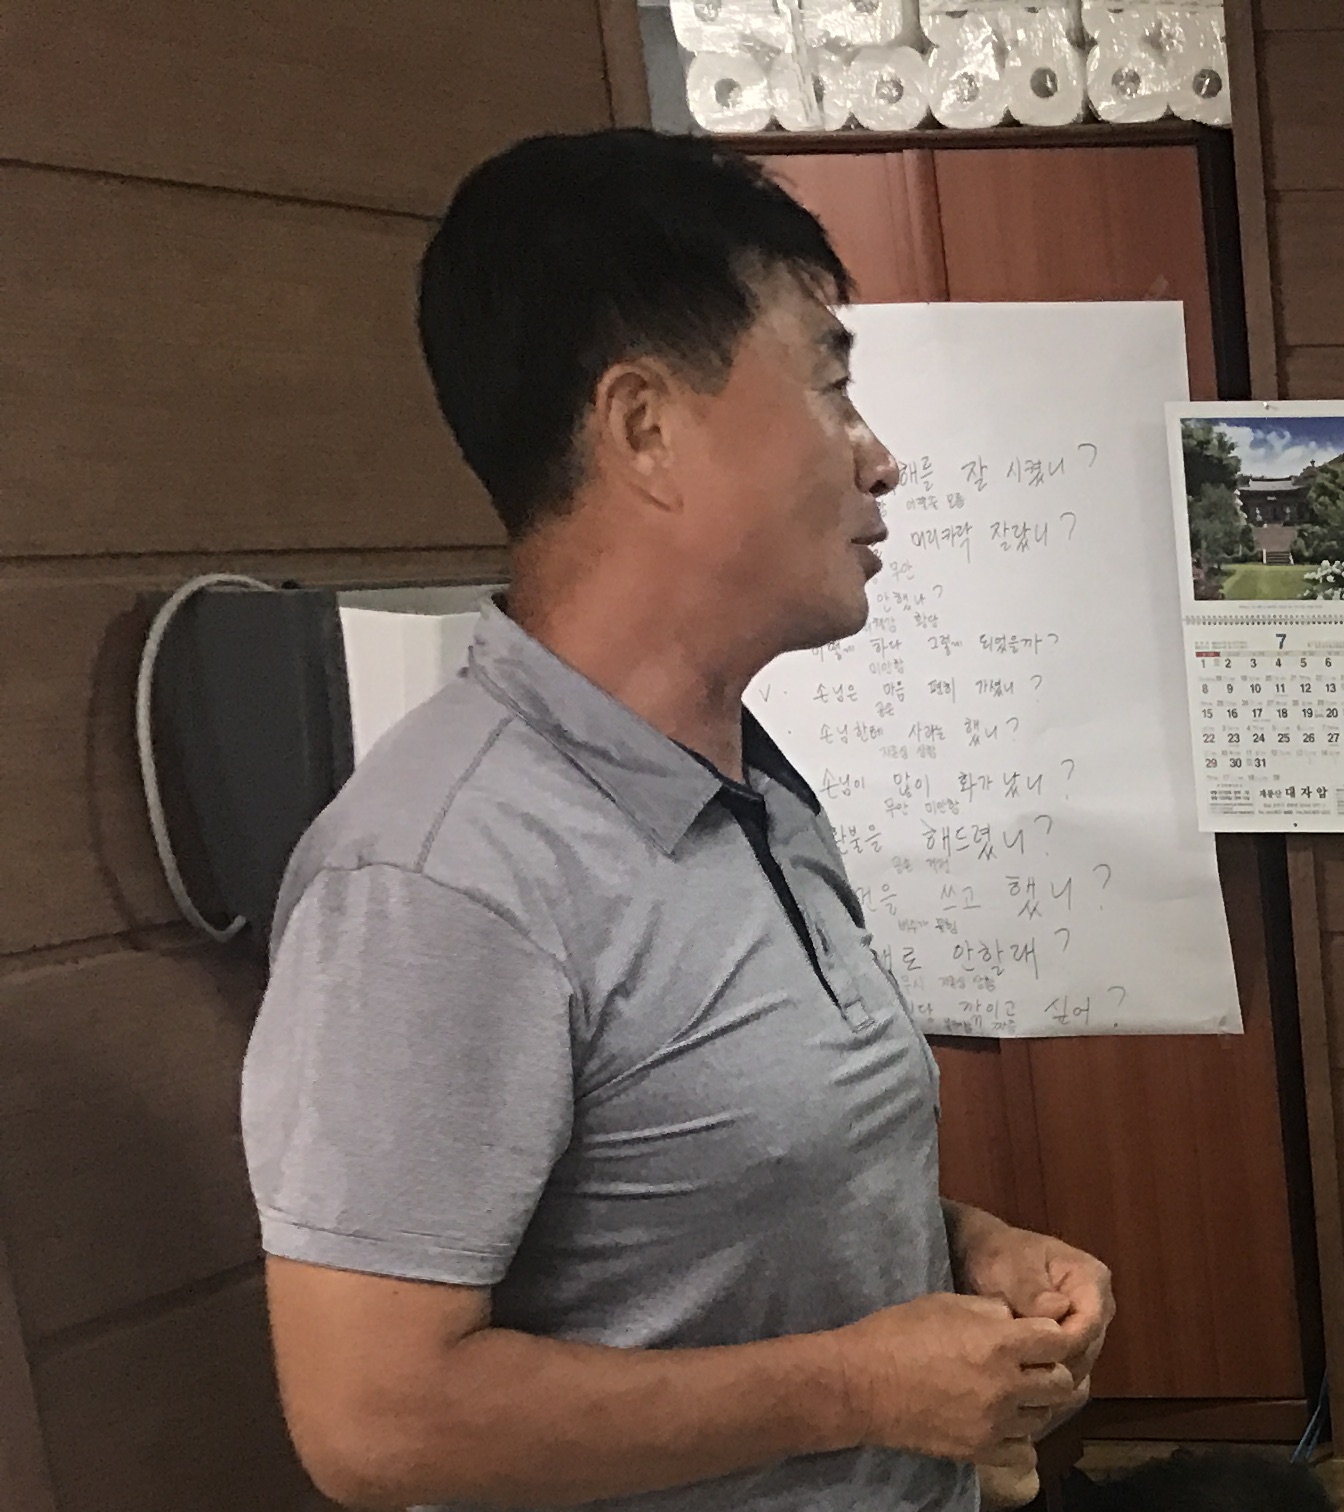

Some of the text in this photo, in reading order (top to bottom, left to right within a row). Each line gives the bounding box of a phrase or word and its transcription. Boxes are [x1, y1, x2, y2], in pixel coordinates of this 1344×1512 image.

[900, 456, 934, 491] 해를
[961, 456, 988, 492] 잘
[1276, 634, 1286, 649] 7
[1201, 659, 1205, 668] 1
[1225, 658, 1231, 668] 2
[1251, 659, 1257, 668] 3
[1276, 658, 1281, 667] 4
[1301, 658, 1307, 668] 5
[1325, 658, 1331, 667] 6
[813, 683, 857, 703] 손님은
[1202, 684, 1208, 694] 8
[1227, 684, 1233, 693] 9
[1250, 684, 1261, 693] 10
[1276, 684, 1285, 693] 11
[1300, 683, 1311, 693] 12
[1325, 683, 1336, 692] 13
[1202, 709, 1213, 718] 15
[1227, 708, 1238, 718] 16
[1252, 708, 1262, 718] 17
[1277, 708, 1288, 718] 18
[1302, 708, 1313, 718] 19
[1326, 708, 1338, 718] 20
[1203, 734, 1215, 743] 22
[1228, 733, 1240, 743] 23
[1253, 733, 1265, 743] 24
[1278, 733, 1290, 743] 25
[1303, 733, 1315, 743] 26
[1328, 733, 1339, 742] 27
[1205, 758, 1266, 768] 29 30 31
[819, 768, 864, 799] 손님이
[893, 771, 929, 798] 많이
[853, 883, 898, 915] 건을
[941, 884, 981, 911] 쓰고
